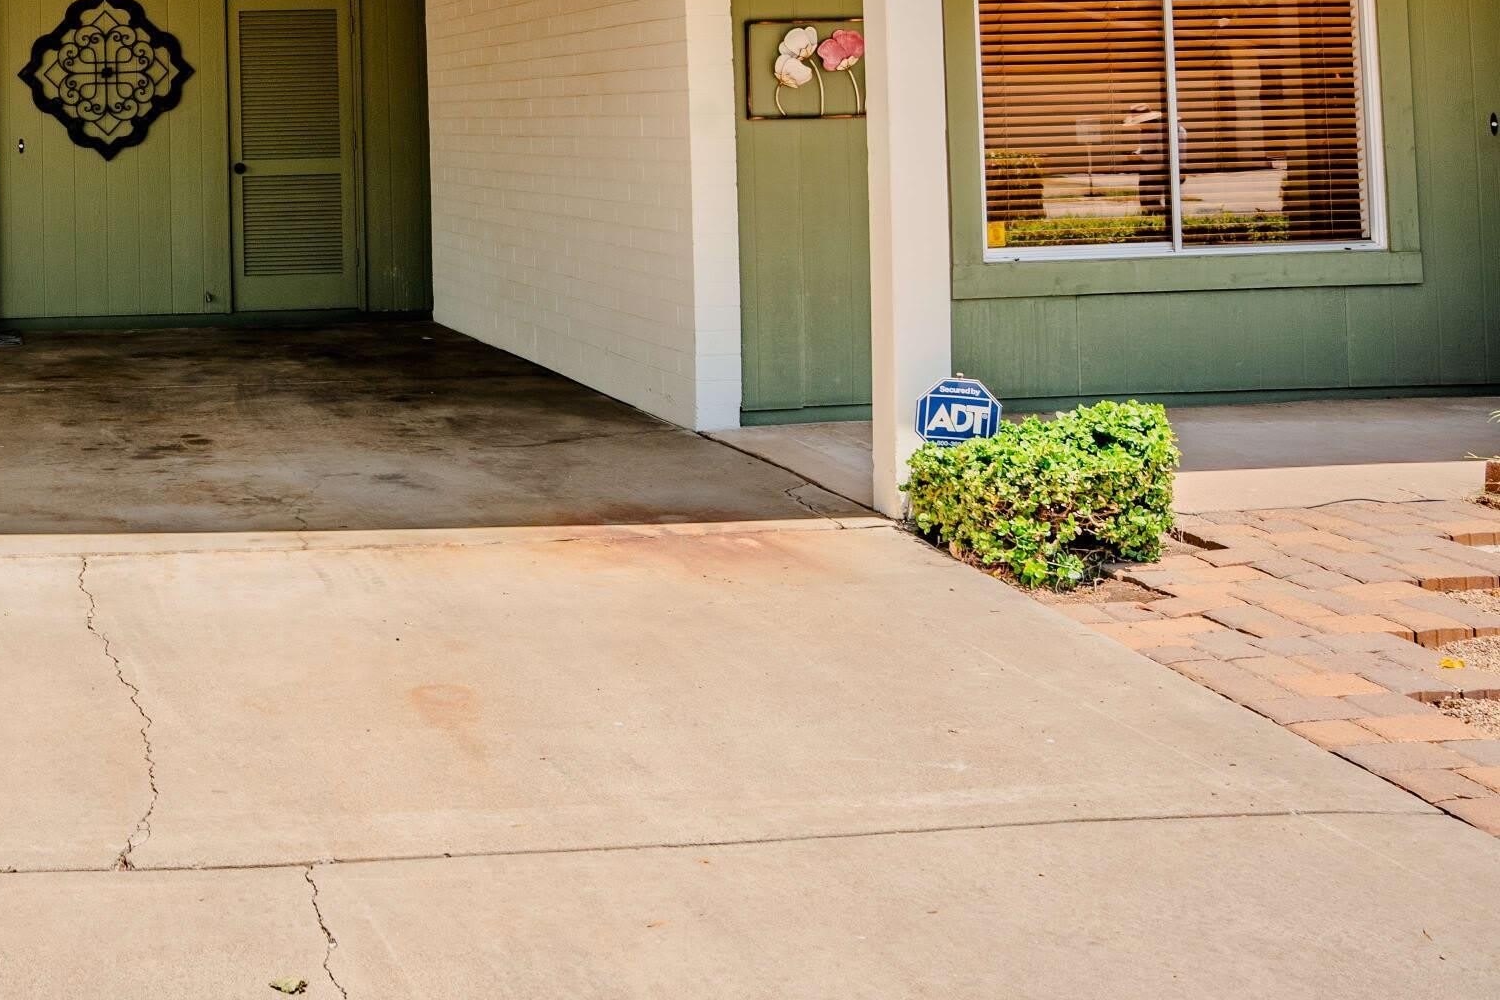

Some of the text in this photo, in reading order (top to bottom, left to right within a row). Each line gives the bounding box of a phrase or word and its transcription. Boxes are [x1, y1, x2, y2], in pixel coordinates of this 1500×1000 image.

[939, 385, 980, 396] Secured by
[927, 403, 989, 434] ADT
